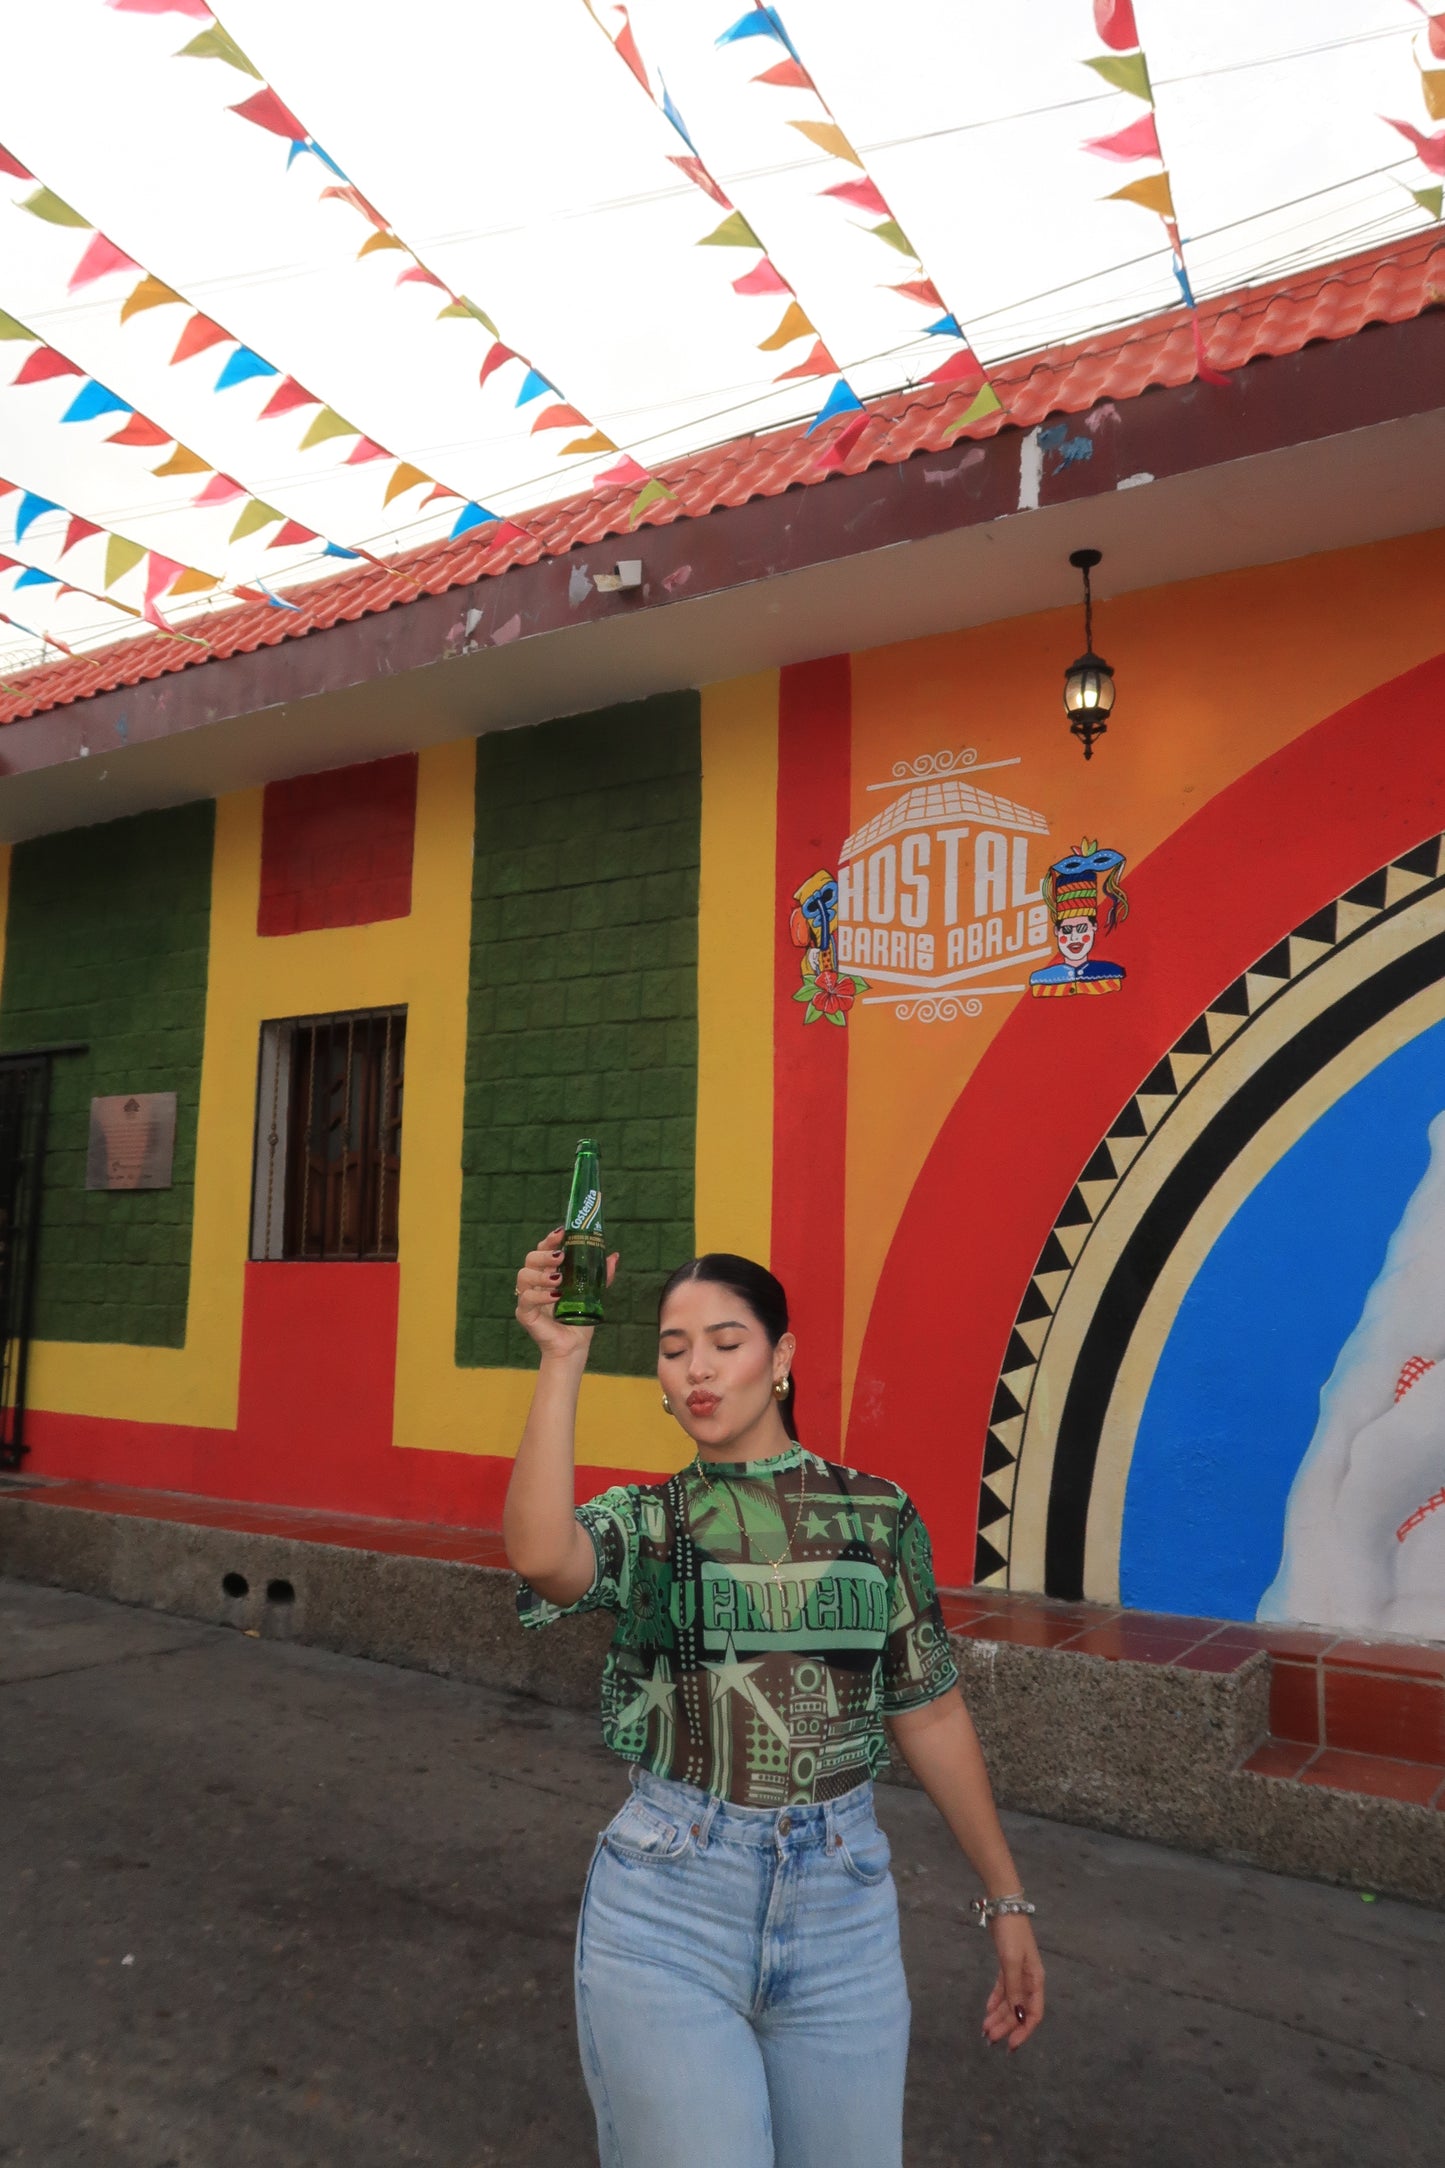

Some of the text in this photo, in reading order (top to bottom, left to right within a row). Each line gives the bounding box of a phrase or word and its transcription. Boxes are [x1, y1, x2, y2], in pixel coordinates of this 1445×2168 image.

[838, 828, 1043, 927] HOSTAL
[838, 906, 1048, 970] BARRIO ABAJO
[571, 1189, 597, 1229] Costeñita
